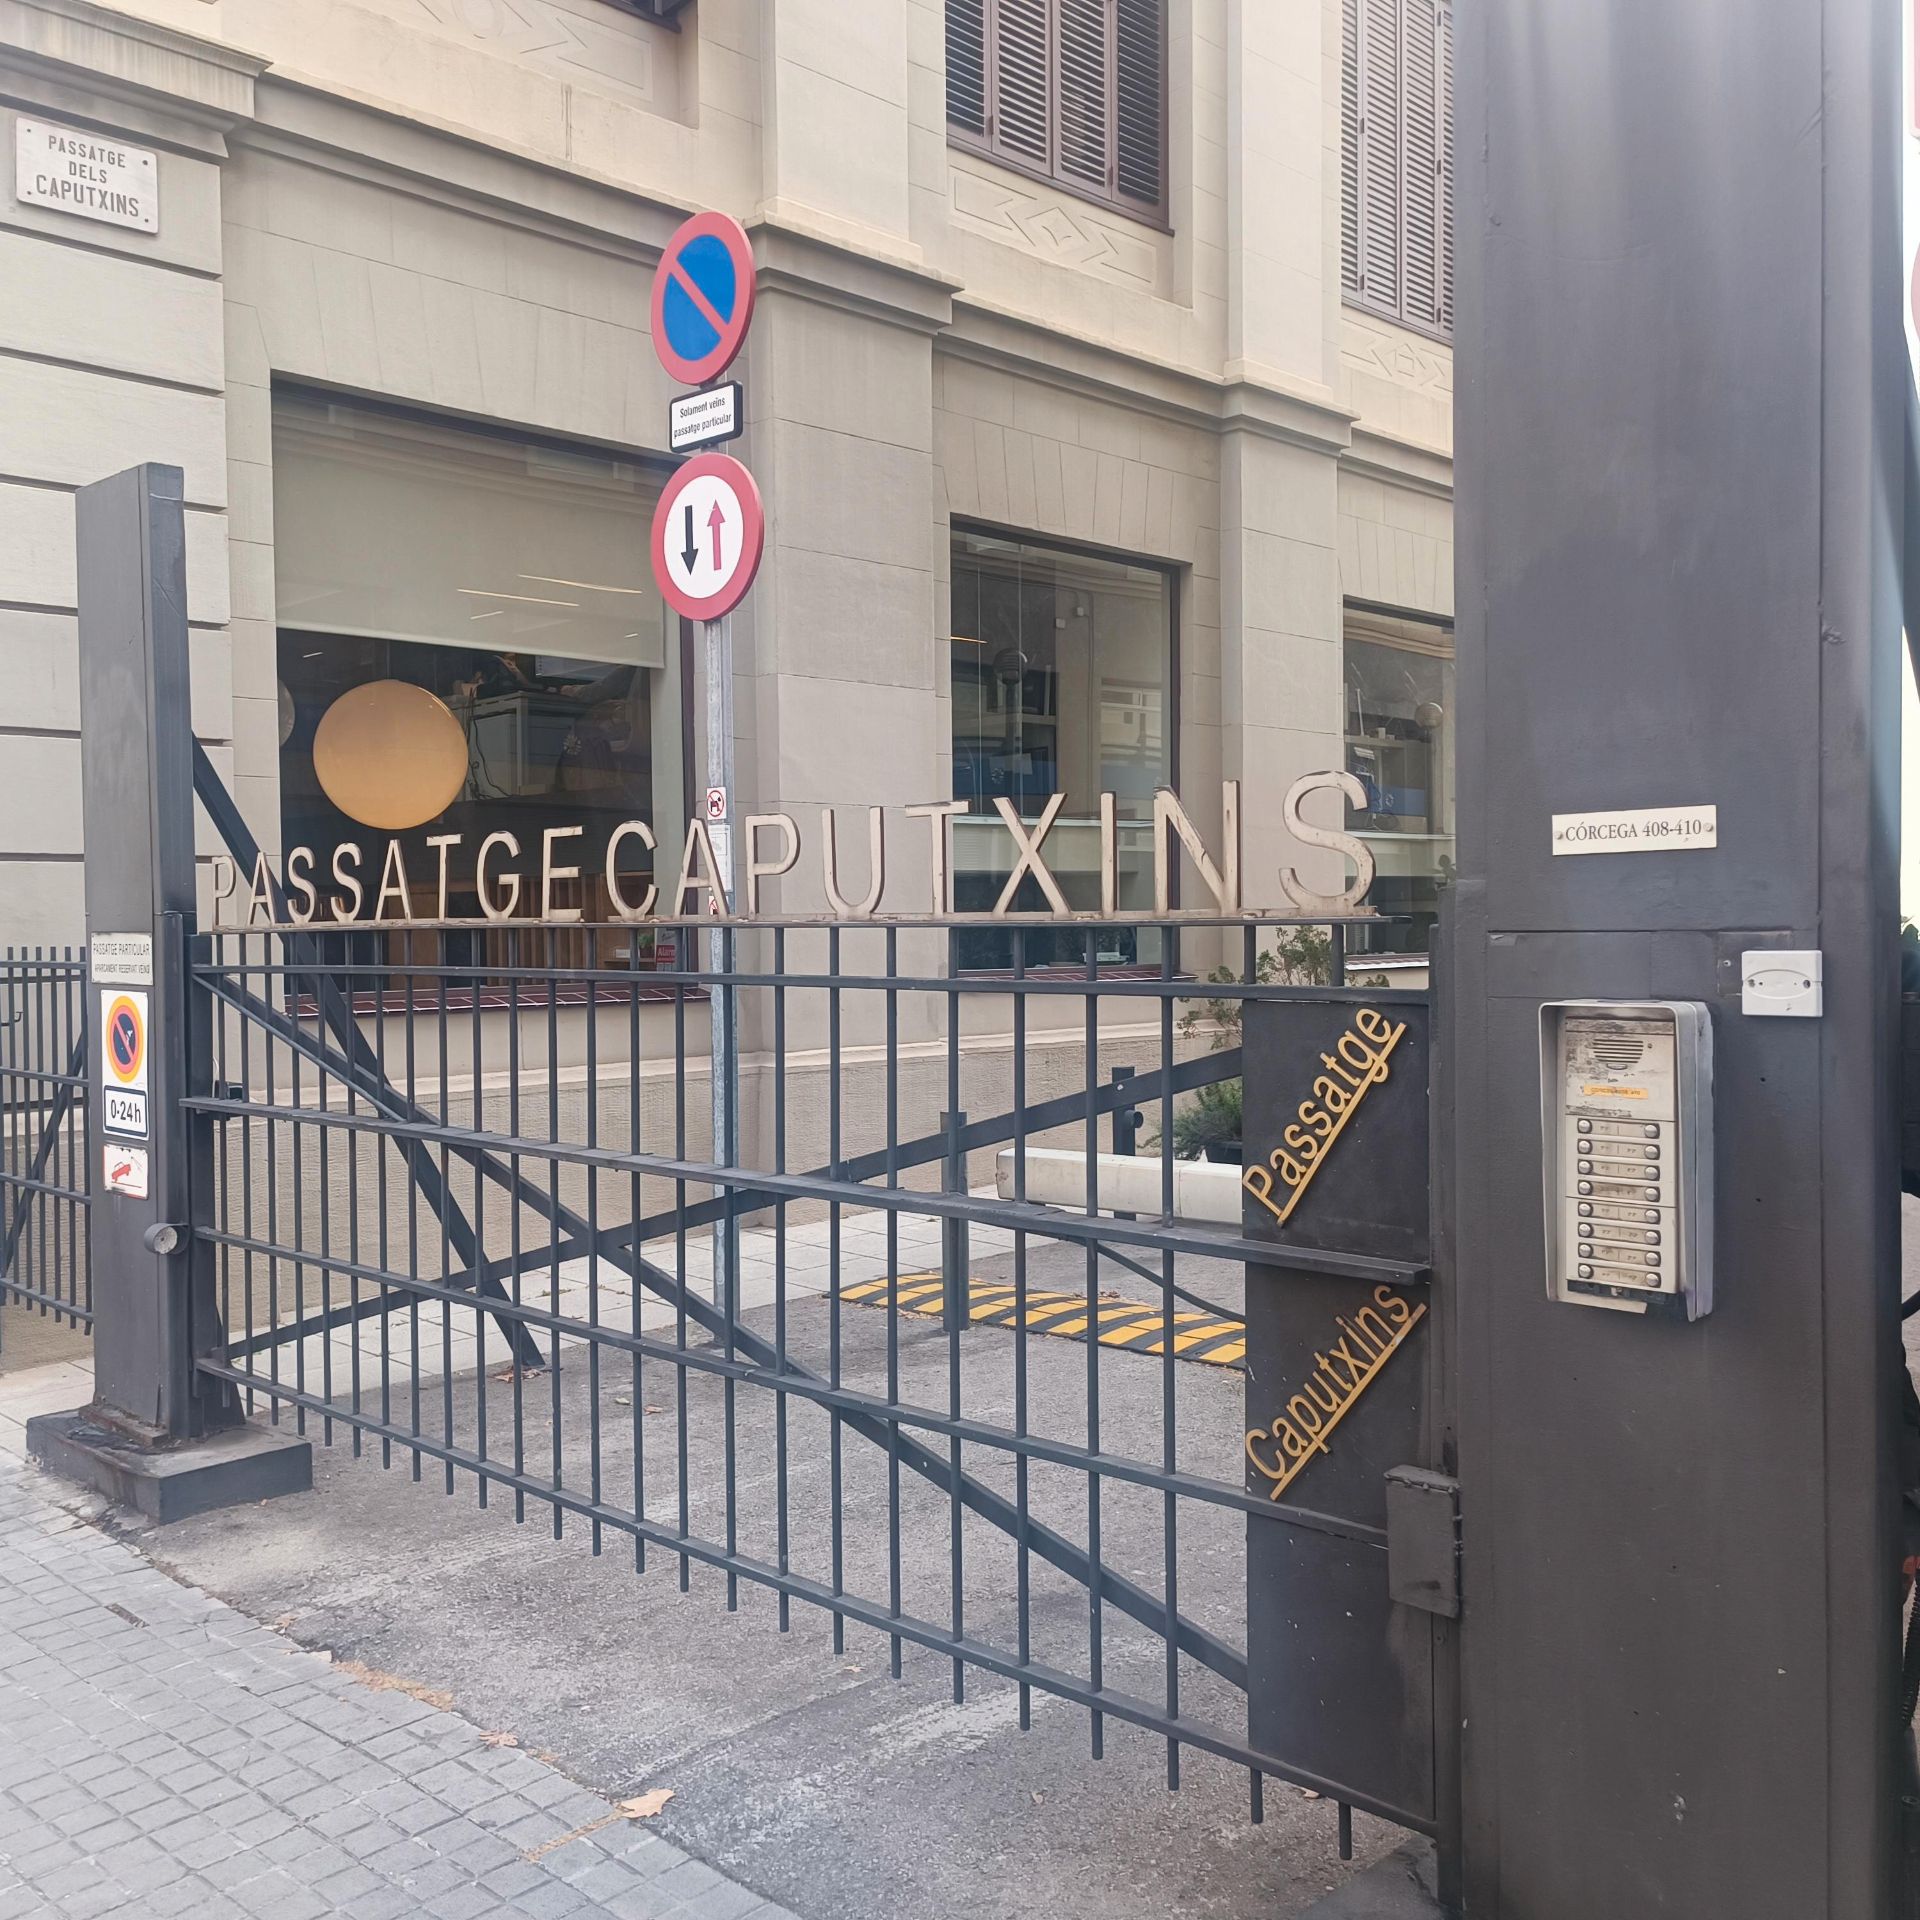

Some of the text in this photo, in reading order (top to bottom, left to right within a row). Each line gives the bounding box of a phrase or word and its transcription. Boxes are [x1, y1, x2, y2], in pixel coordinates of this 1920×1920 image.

[48, 135, 126, 168] PASSATGE
[68, 161, 108, 184] DELS
[36, 174, 139, 217] CAPUTXINS
[673, 413, 732, 439] passatge particular
[679, 401, 708, 418] Solament
[1565, 819, 1702, 842] CÓRCEGA 408-410
[211, 770, 1377, 928] PASSATGE CAPUTXINS
[1242, 1007, 1393, 1217] Passatge
[1245, 1284, 1412, 1481] Caputxins
